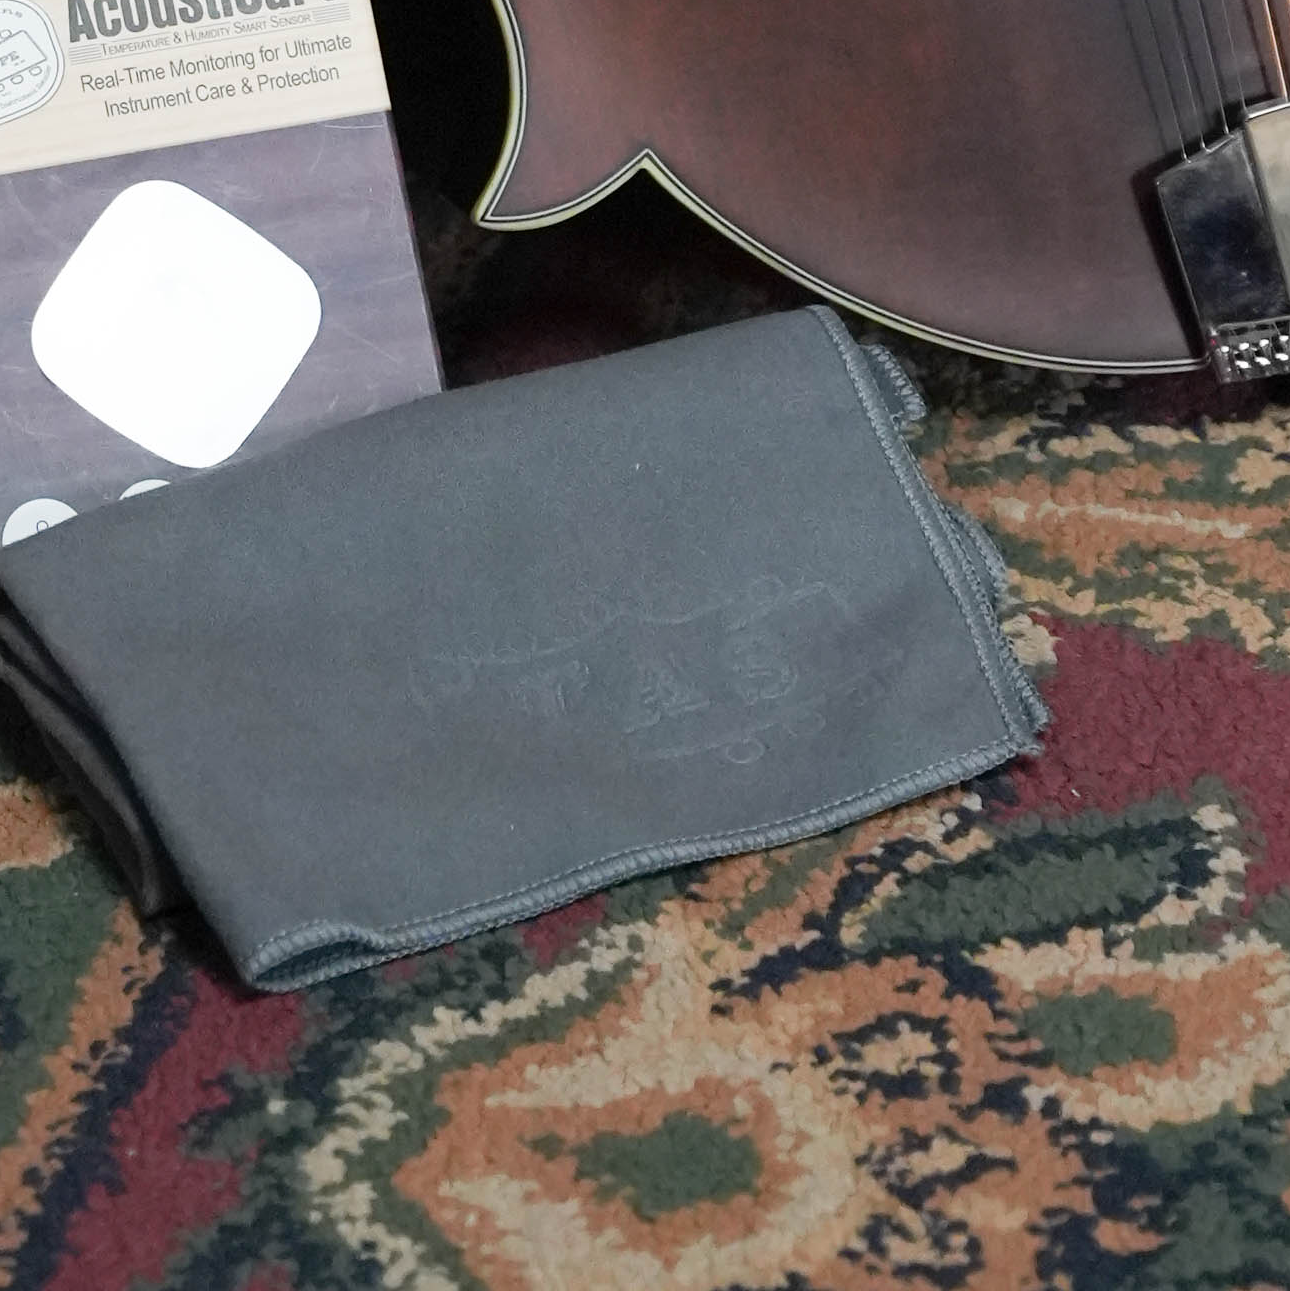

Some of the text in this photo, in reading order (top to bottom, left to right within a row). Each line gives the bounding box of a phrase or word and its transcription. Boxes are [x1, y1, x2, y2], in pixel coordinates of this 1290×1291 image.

[80, 64, 166, 93] Real-Time
[169, 50, 256, 79] Monitoring
[259, 45, 281, 63] for
[284, 34, 353, 59] Ultimate
[173, 31, 183, 45] &
[104, 64, 341, 118] Instrument Care & Protection
